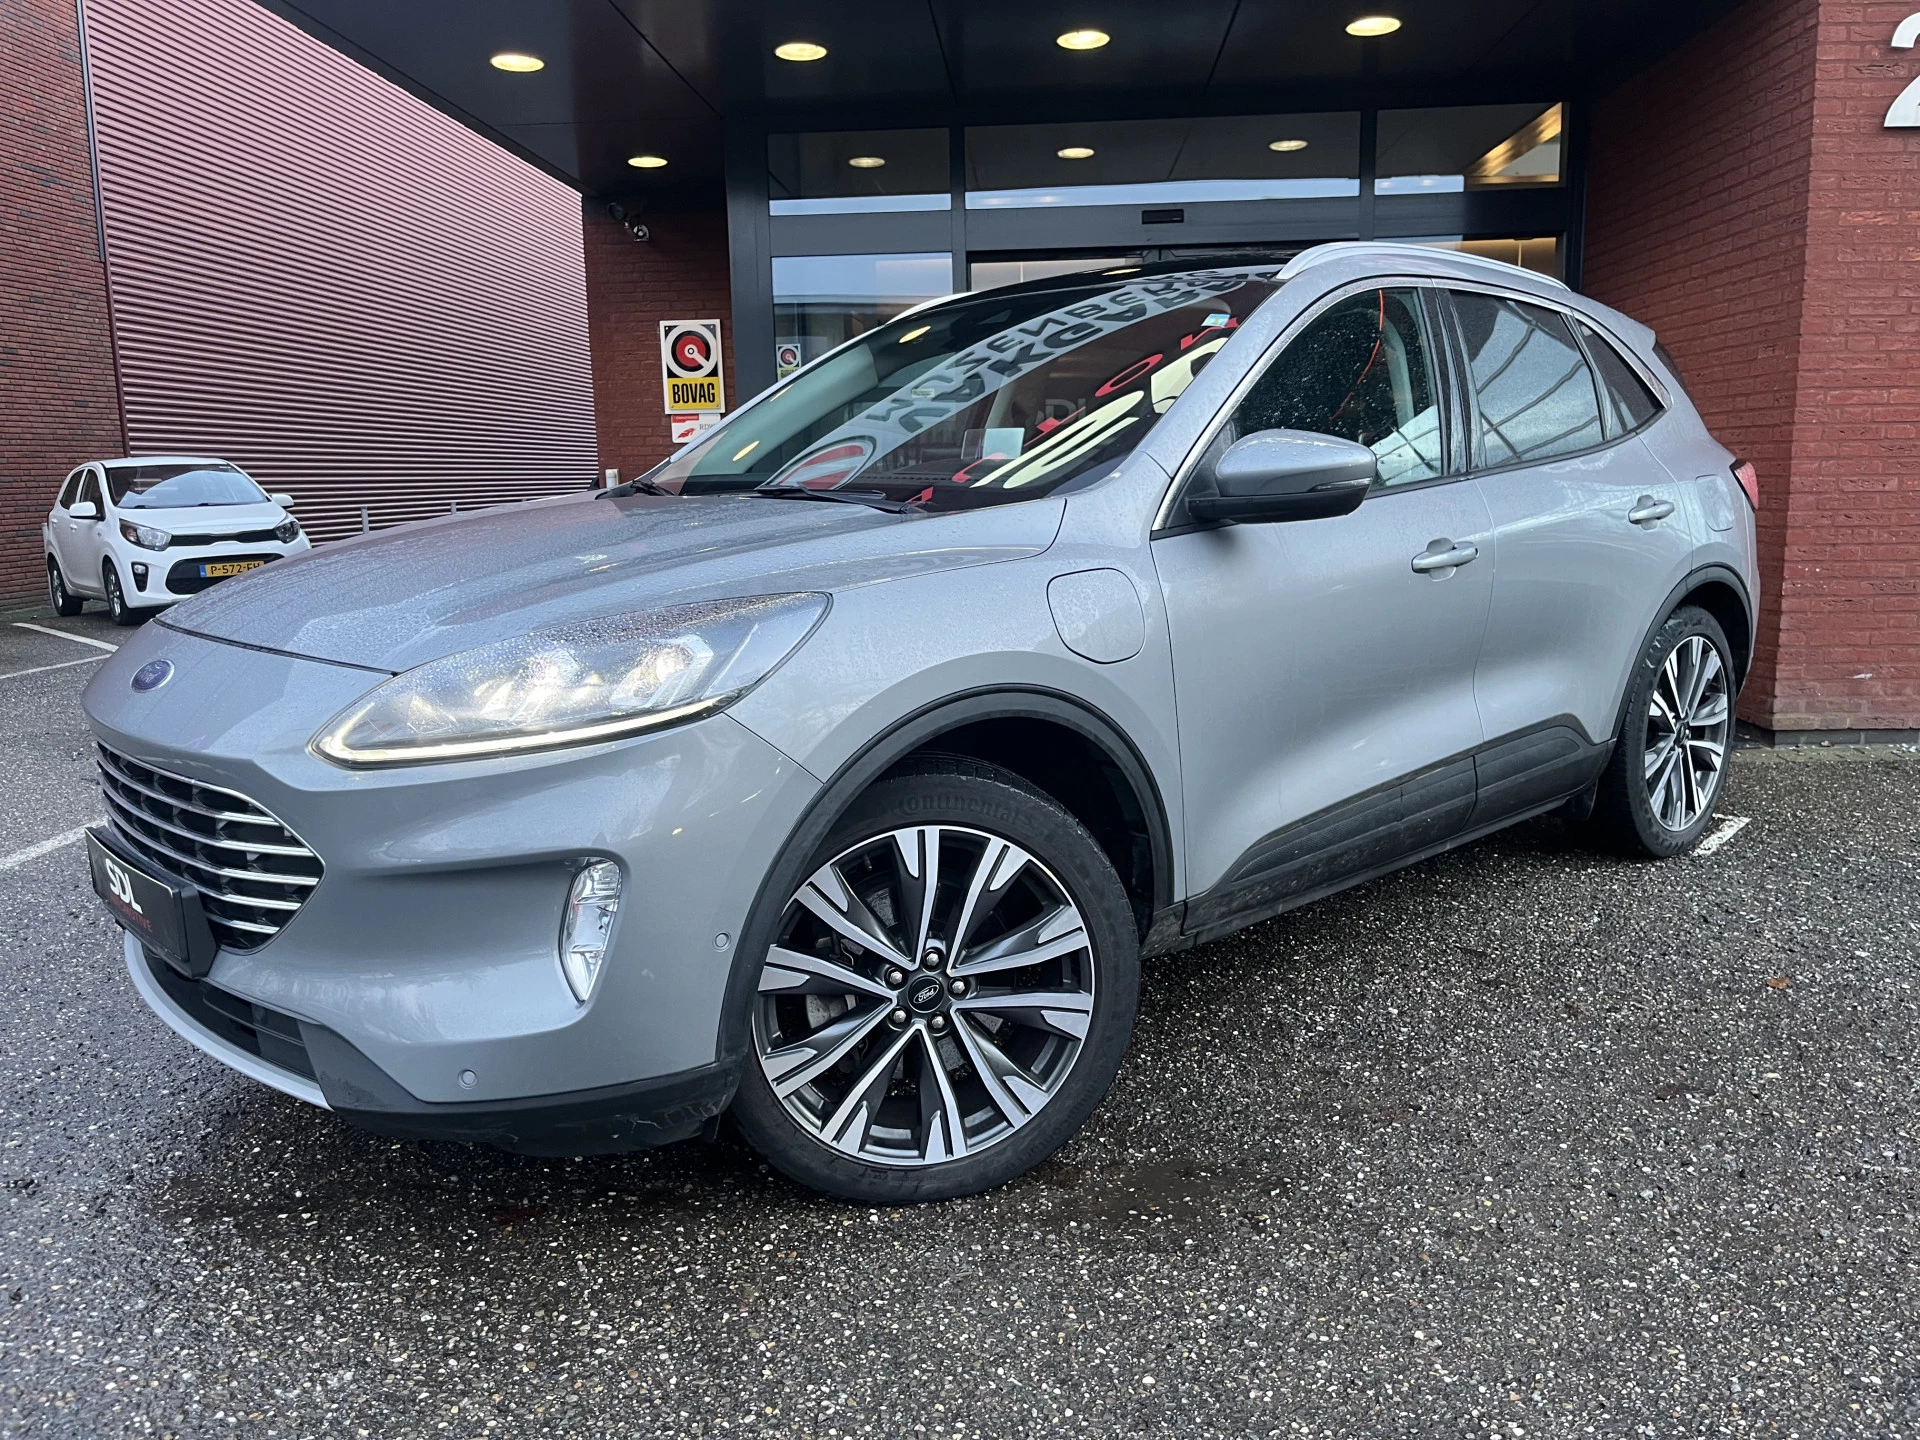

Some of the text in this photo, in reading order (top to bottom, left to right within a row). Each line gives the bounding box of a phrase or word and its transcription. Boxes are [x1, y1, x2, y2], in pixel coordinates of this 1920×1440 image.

[672, 383, 715, 404] BOVAG
[897, 790, 1018, 824] Continental
[105, 858, 143, 914] SDL
[917, 987, 935, 1002] Ford
